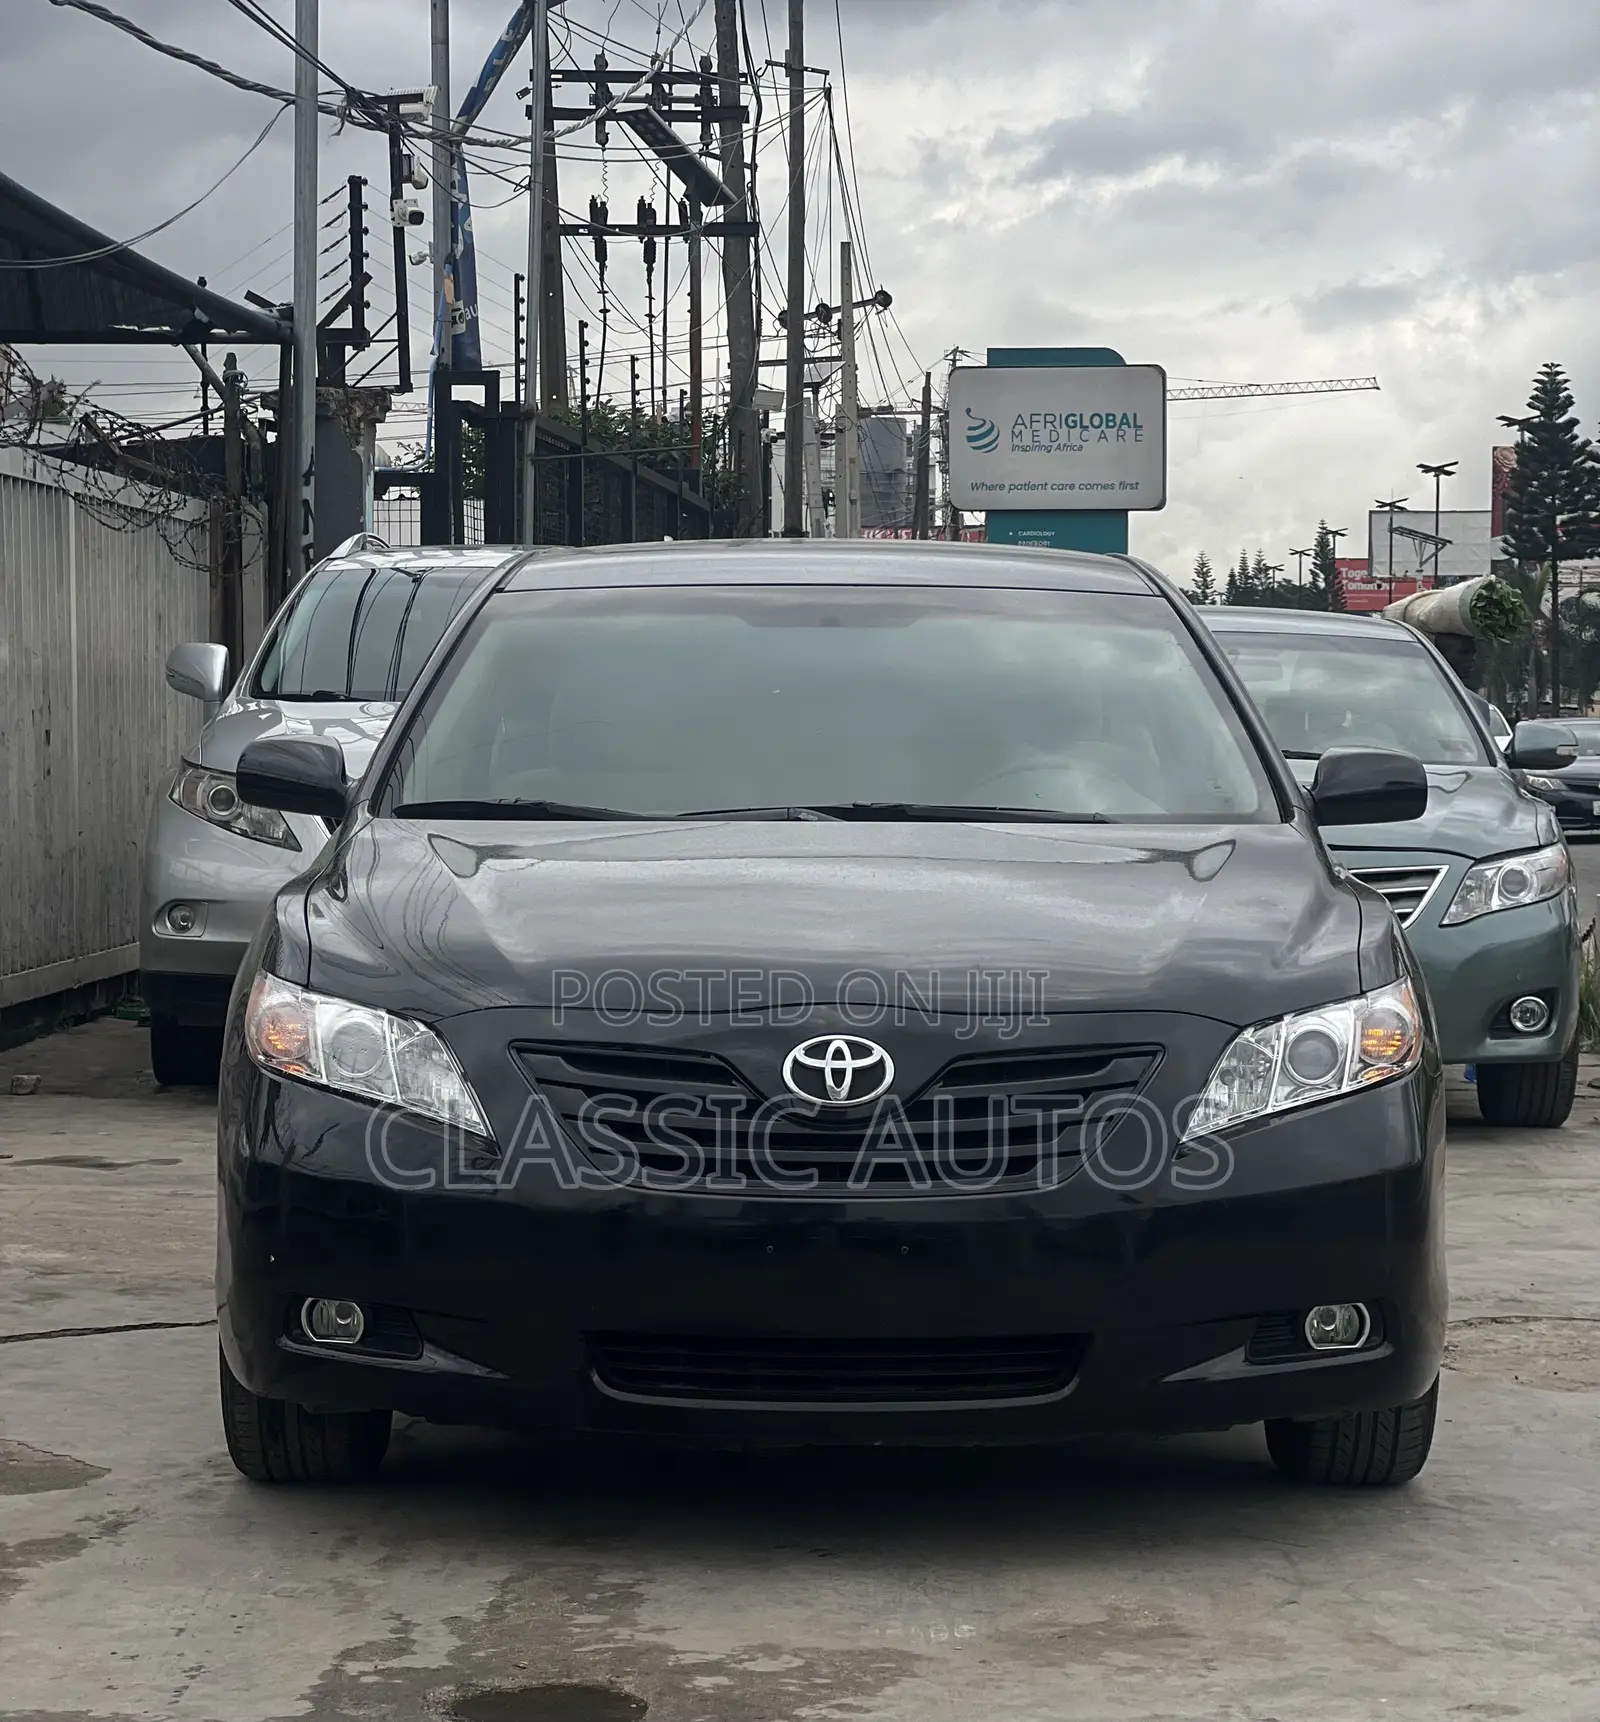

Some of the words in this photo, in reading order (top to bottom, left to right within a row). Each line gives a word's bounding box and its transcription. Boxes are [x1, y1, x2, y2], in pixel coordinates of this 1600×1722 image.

[1012, 413, 1144, 429] AFRIGLOBAL
[1011, 429, 1144, 443] MEDICARE
[1011, 443, 1052, 453] Inspiring
[1054, 443, 1084, 452] Africa
[970, 482, 1005, 491] Where
[1008, 481, 1048, 493] patient
[1050, 483, 1075, 491] care
[1078, 482, 1114, 491] comes
[1118, 481, 1140, 490] first
